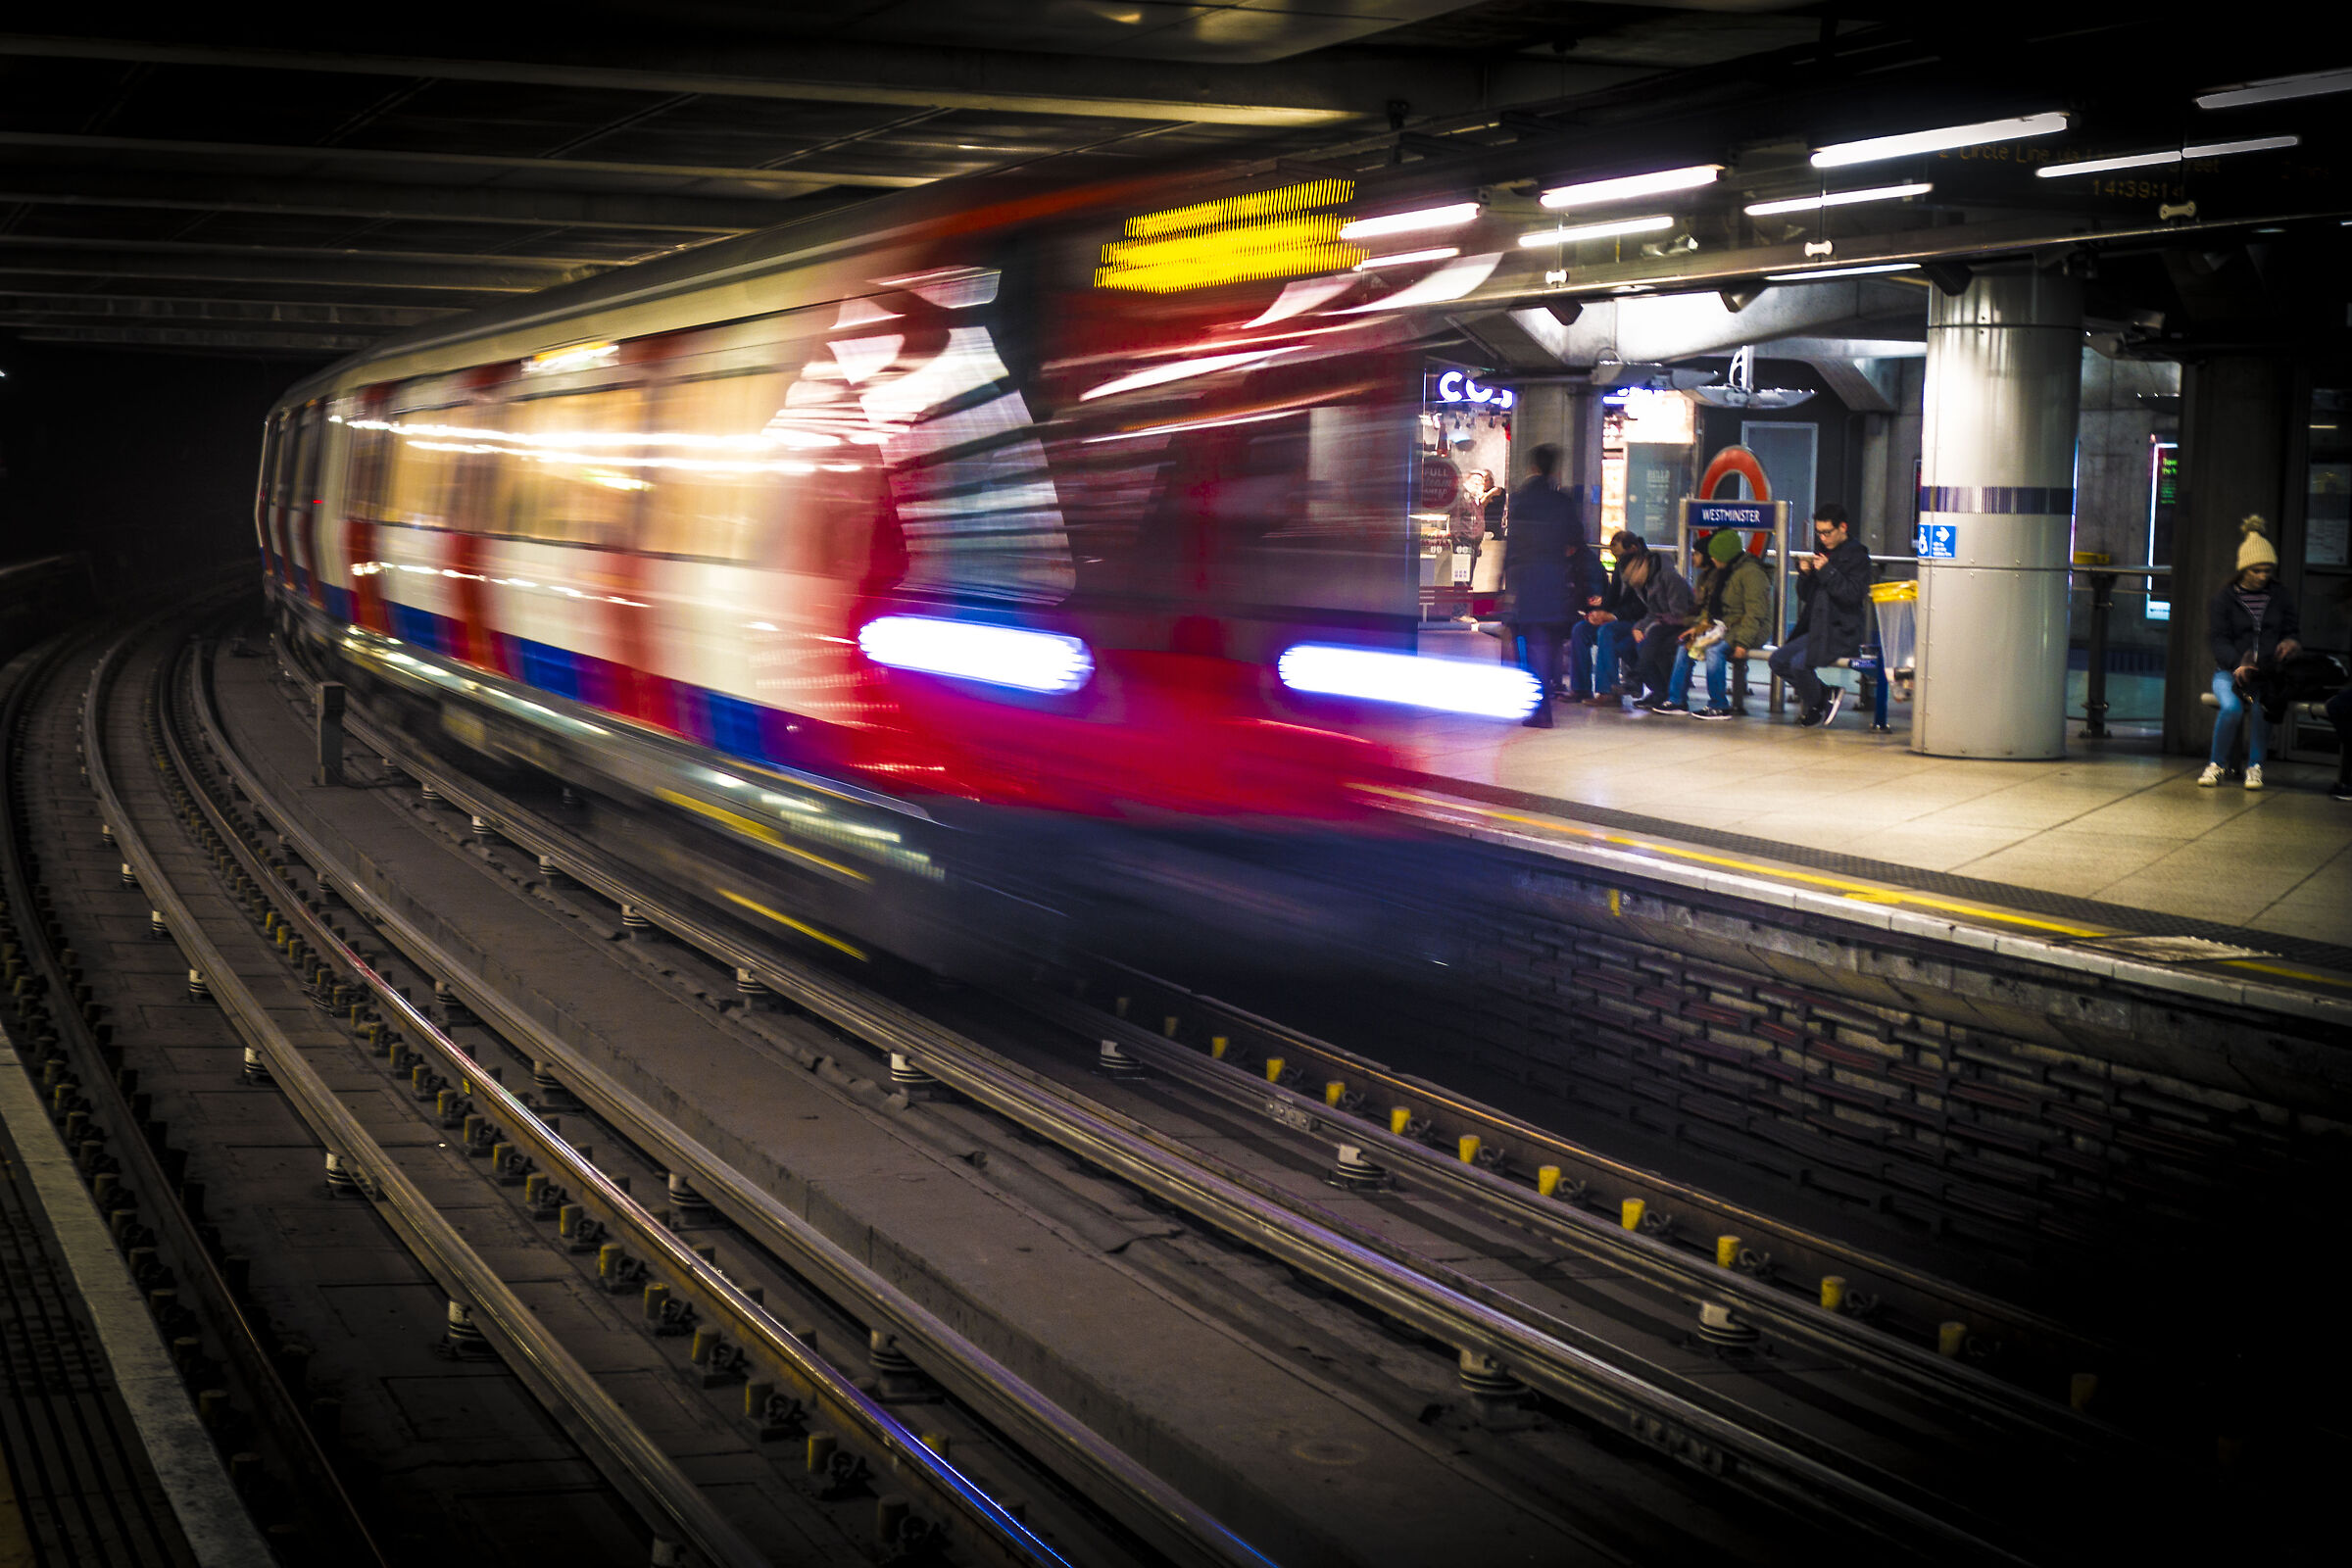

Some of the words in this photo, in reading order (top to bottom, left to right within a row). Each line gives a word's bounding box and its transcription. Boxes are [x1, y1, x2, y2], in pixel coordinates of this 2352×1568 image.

[1959, 143, 2009, 161] Circle
[2015, 144, 2050, 165] Line
[1701, 508, 1761, 523] WESTMINSTER
